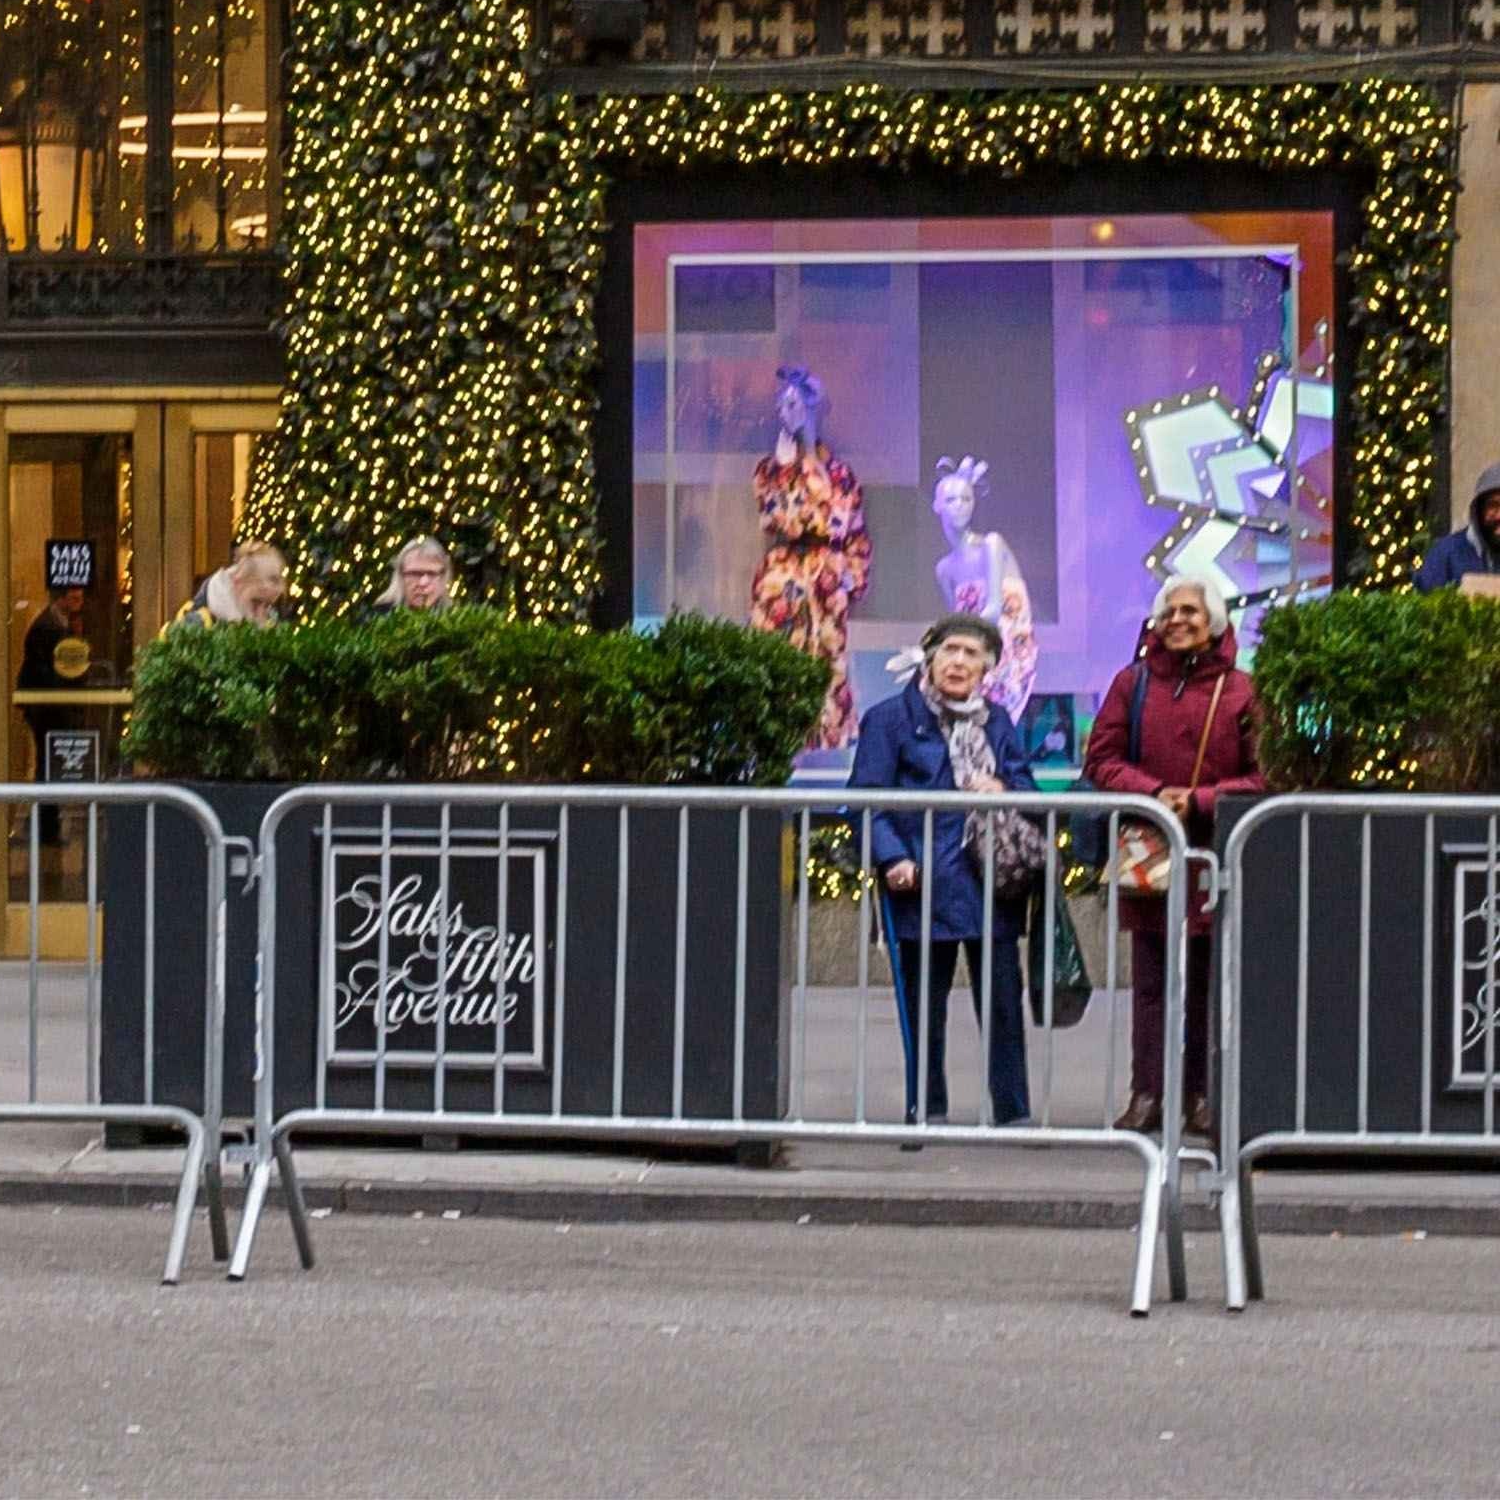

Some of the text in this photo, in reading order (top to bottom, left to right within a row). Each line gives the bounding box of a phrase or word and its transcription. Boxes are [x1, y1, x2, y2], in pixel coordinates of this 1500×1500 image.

[51, 544, 91, 561] SAKS
[334, 874, 465, 951] Saks
[334, 958, 519, 1034] Avenue
